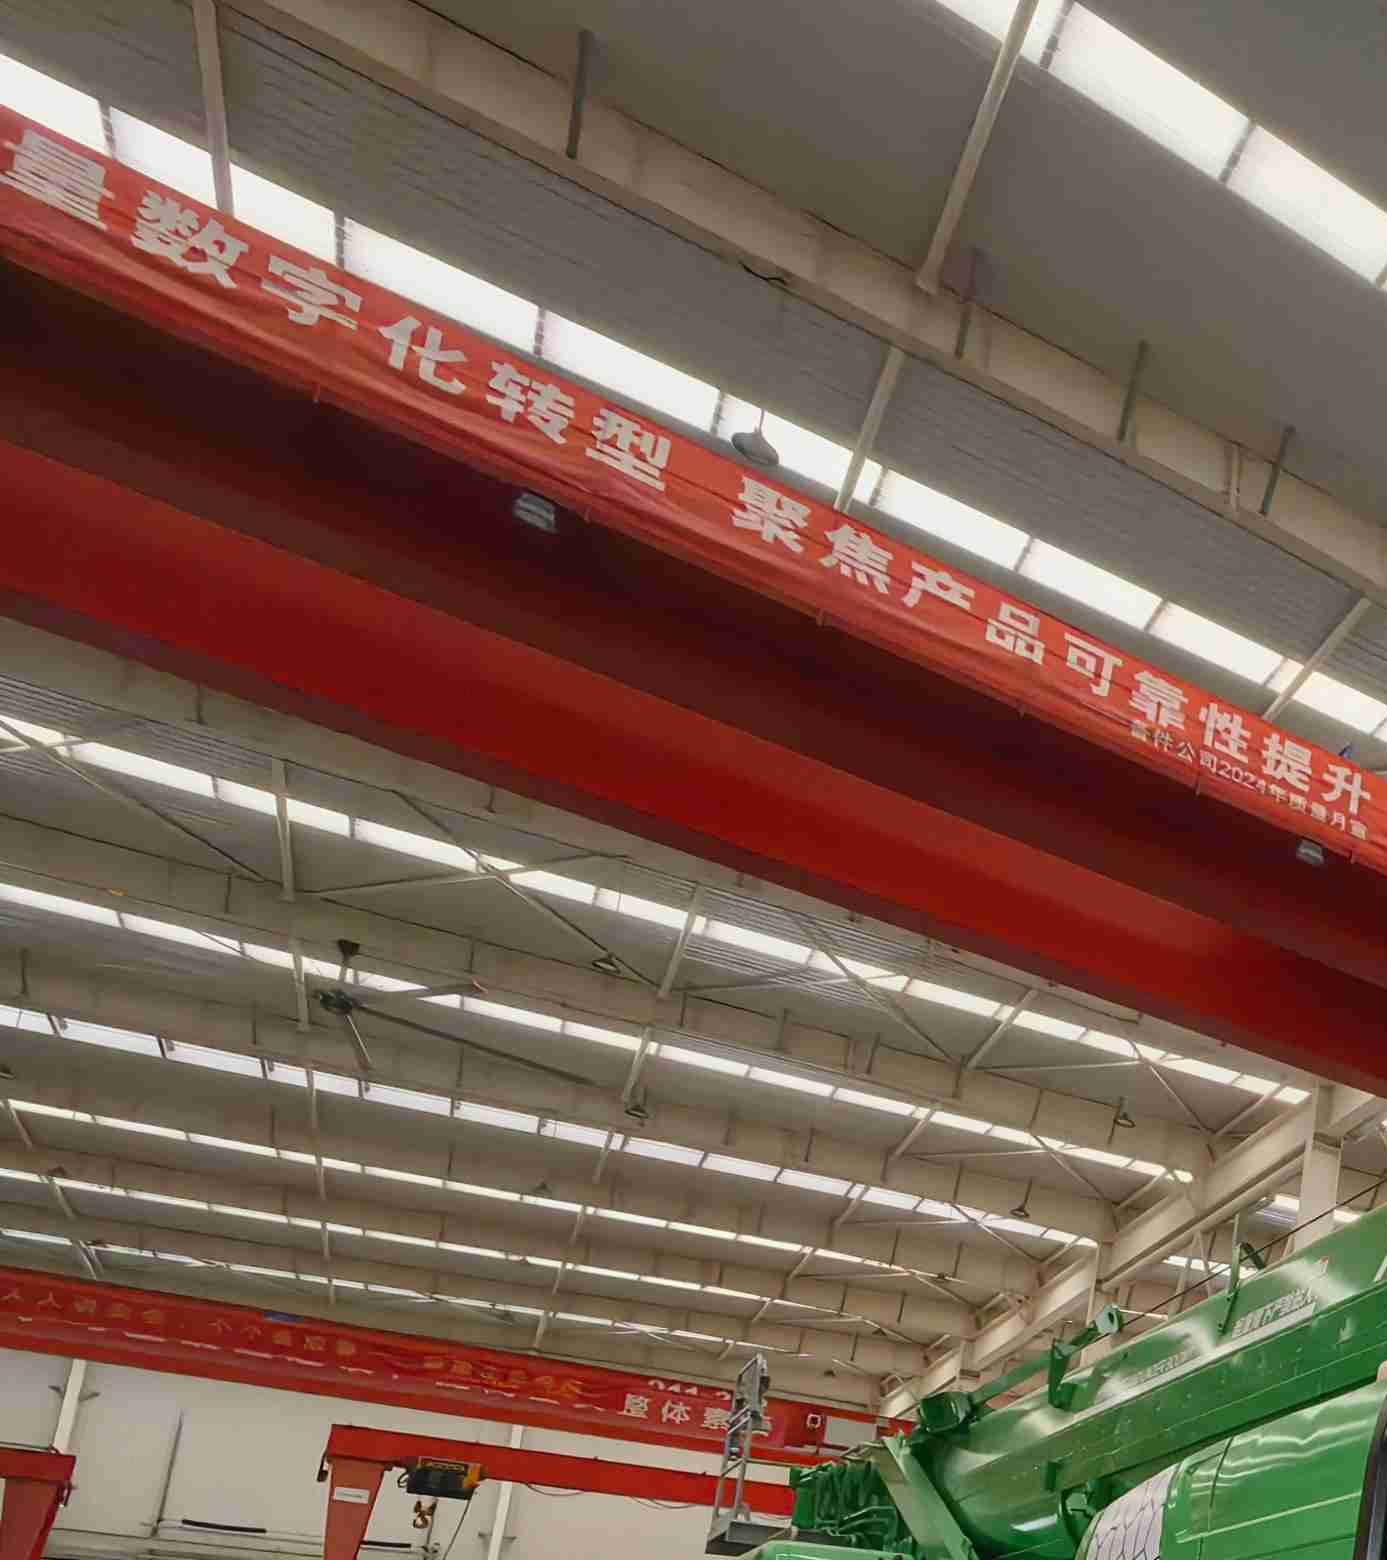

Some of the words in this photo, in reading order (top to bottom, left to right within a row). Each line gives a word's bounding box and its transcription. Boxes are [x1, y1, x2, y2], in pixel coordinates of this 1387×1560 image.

[731, 475, 1371, 815] 聚焦产品可靠性提升
